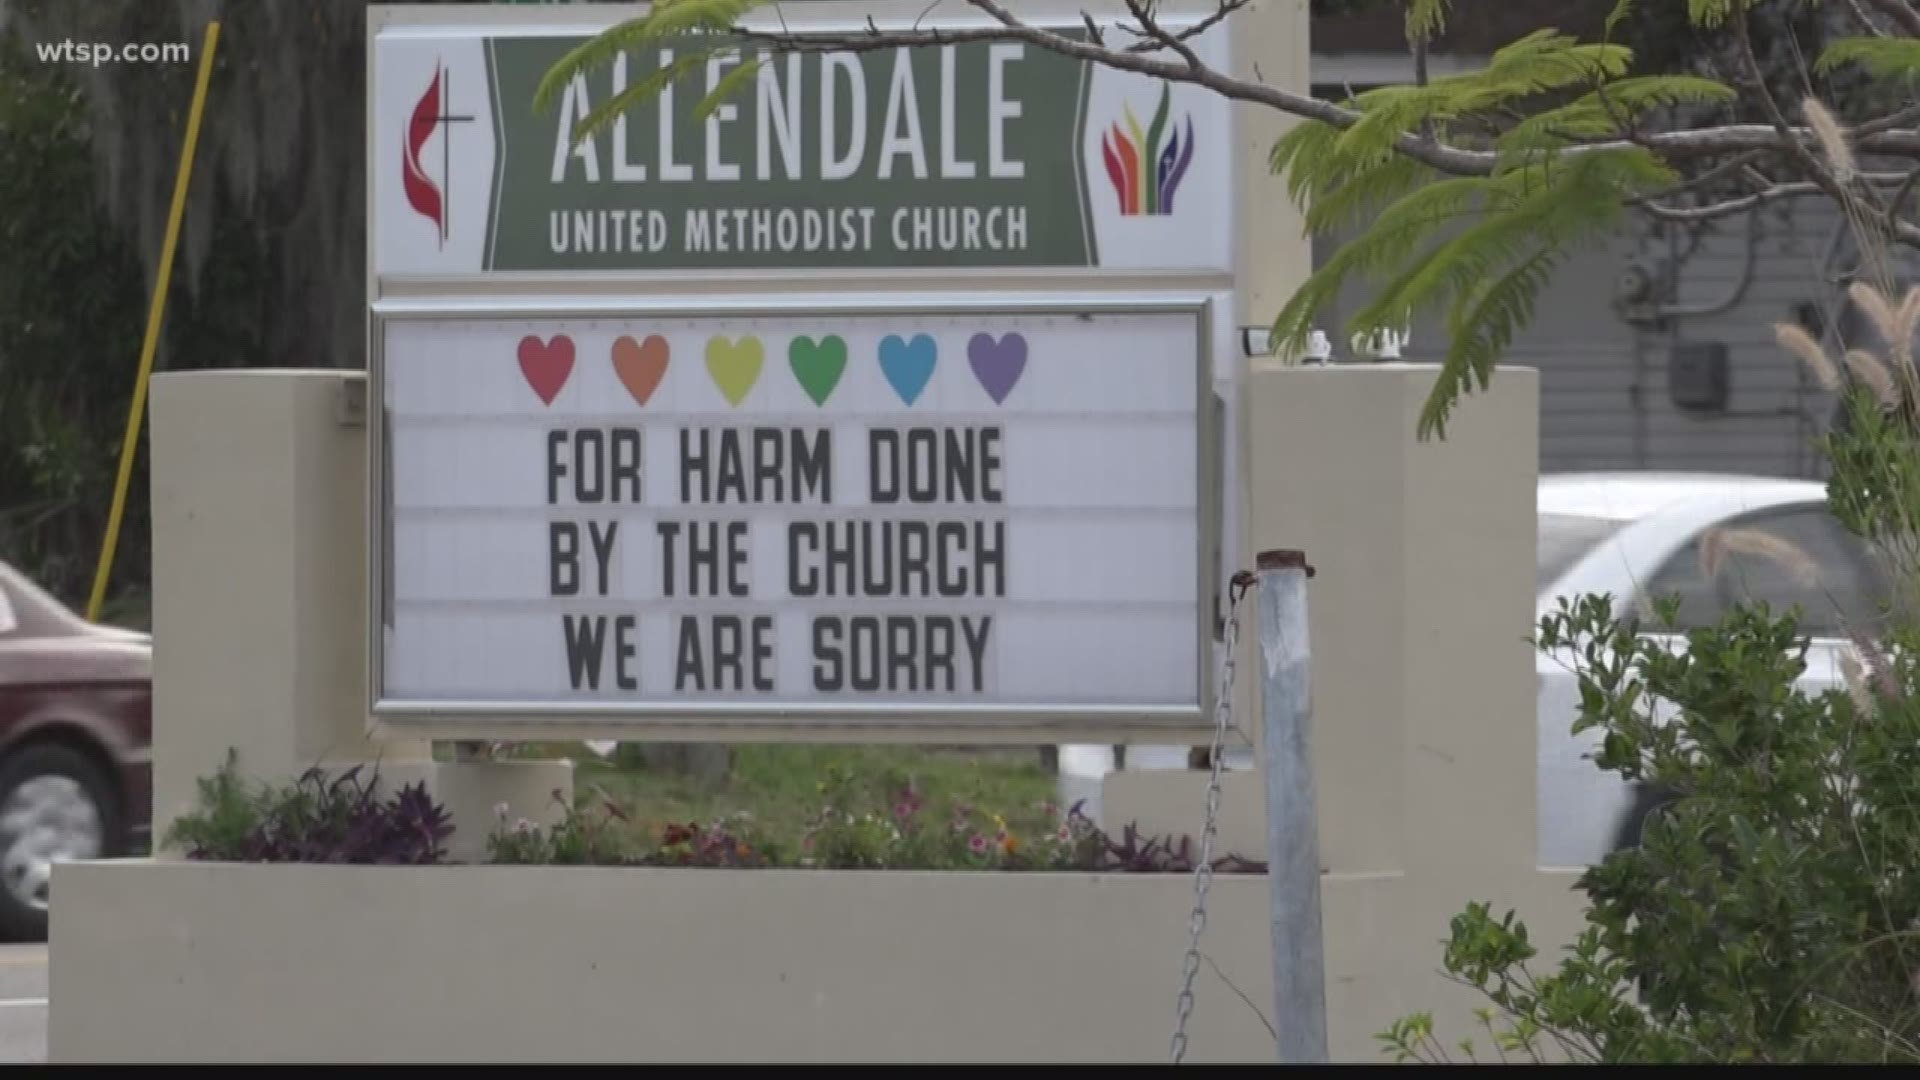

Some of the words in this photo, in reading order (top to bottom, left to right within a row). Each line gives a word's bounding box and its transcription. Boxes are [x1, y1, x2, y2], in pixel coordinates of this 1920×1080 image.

[551, 44, 1025, 183] ALLENDALE
[550, 209, 667, 253] UNITED
[684, 207, 875, 252] METHODIST
[891, 207, 1028, 250] CHURCH
[547, 429, 642, 504] FOR
[680, 428, 832, 504] HARM
[869, 427, 1003, 503] DONE
[550, 522, 619, 596] BY
[657, 522, 748, 596] THE
[788, 521, 1006, 597] CHURCH
[563, 616, 637, 690] WE
[674, 616, 773, 691] ARE
[812, 616, 992, 692] SORRY
